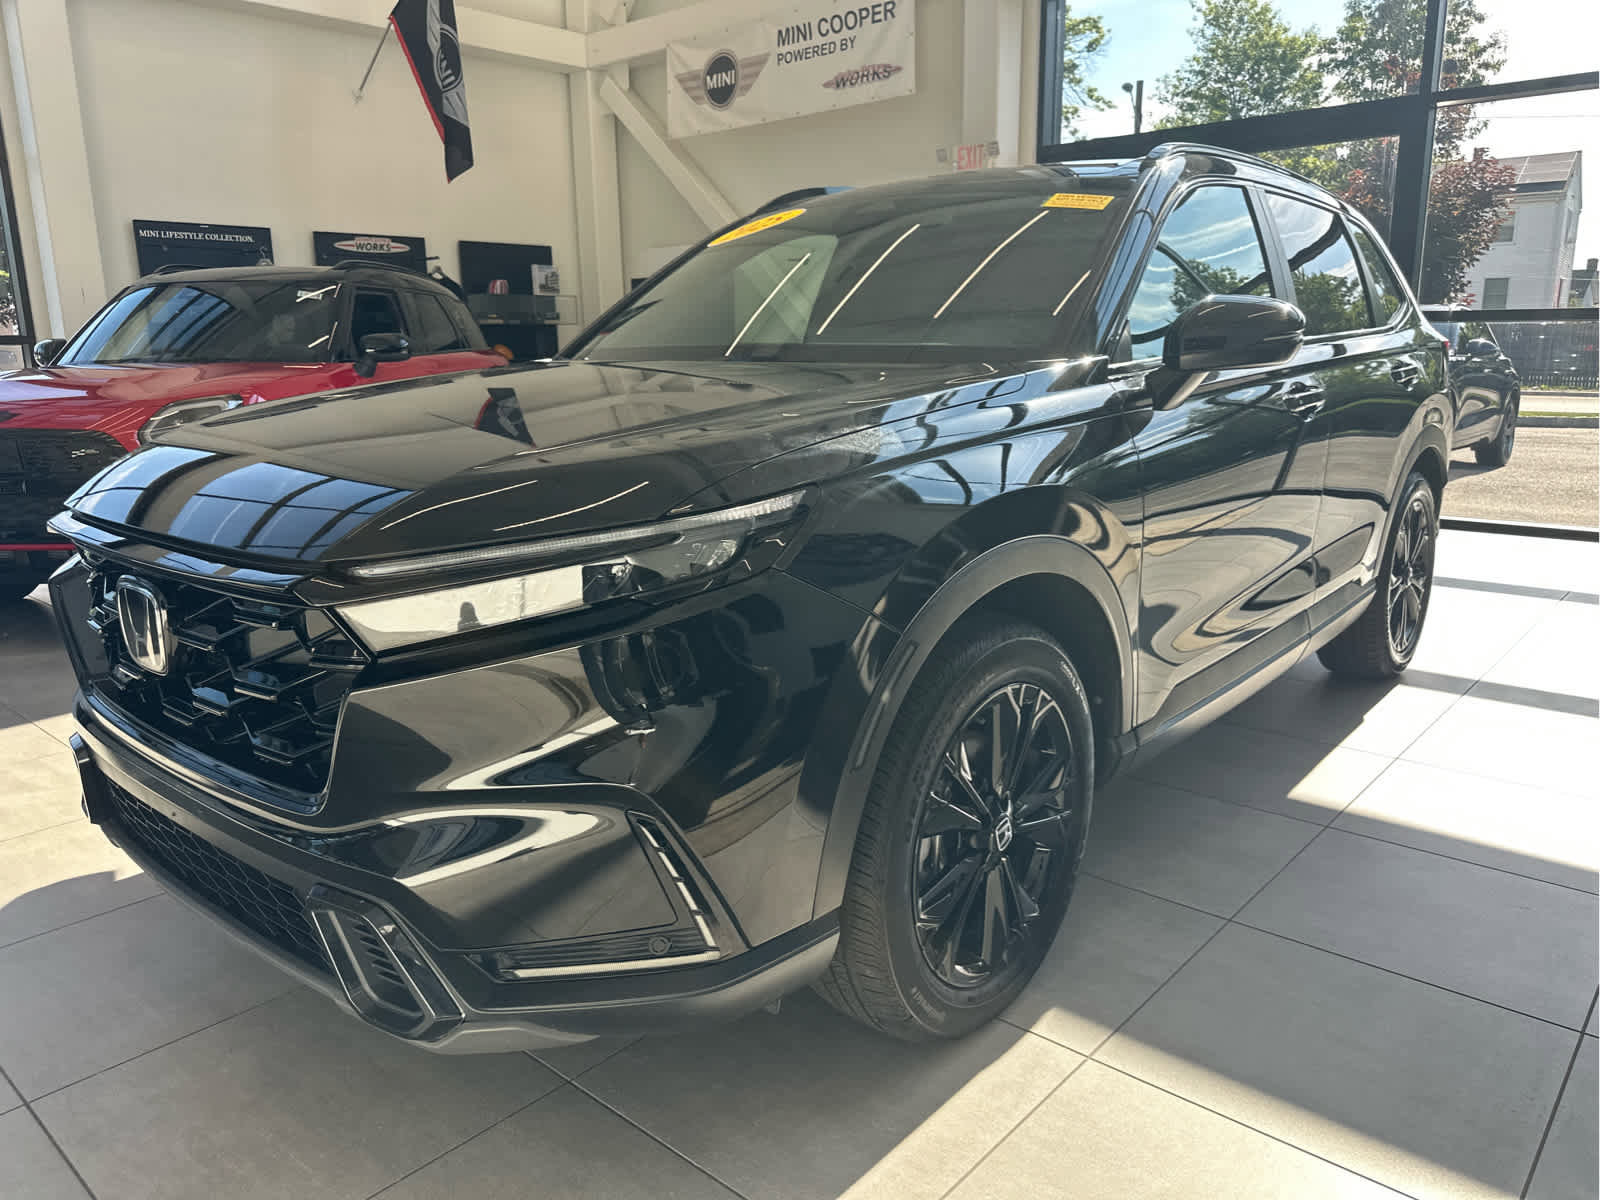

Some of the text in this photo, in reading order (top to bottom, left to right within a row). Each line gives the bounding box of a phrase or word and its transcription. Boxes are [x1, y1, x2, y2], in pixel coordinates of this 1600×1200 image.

[777, 0, 897, 48] MINI COOPER
[776, 35, 857, 66] POWERED BY
[706, 70, 735, 90] MINI
[835, 65, 892, 89] WORKS
[957, 144, 985, 170] EXIT
[139, 229, 159, 238] MINI
[161, 230, 204, 240] LIFESTYLE
[354, 241, 392, 252] WORKS
